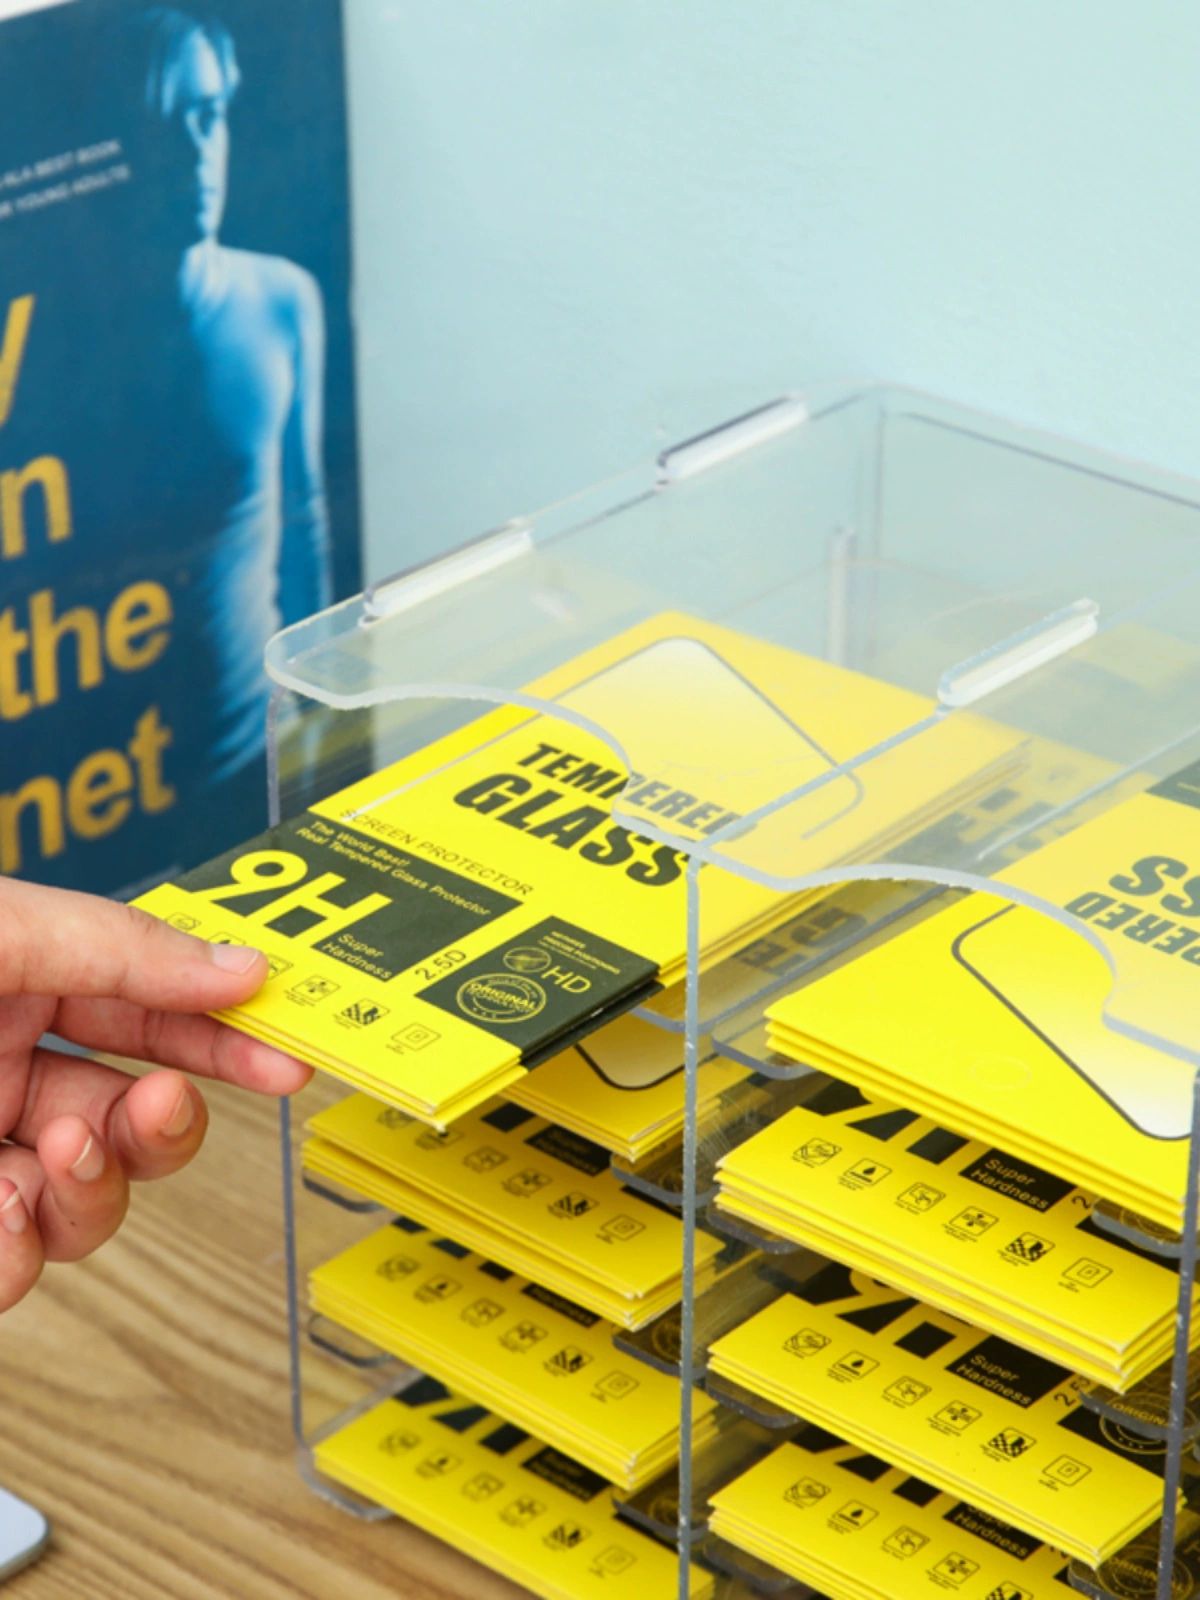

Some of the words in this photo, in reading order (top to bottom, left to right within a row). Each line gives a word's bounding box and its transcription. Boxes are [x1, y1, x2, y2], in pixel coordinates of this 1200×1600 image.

[0, 581, 172, 720] the
[311, 820, 335, 836] The
[453, 773, 702, 886] GLASS
[340, 810, 420, 845] SCREEN
[416, 839, 534, 897] PROTECTOR
[188, 850, 393, 946] 9H
[329, 839, 392, 873] Tempered
[391, 868, 428, 889] Glass
[428, 884, 492, 916] Protector
[321, 941, 394, 980] Hardness
[337, 933, 385, 959] Super
[414, 949, 467, 981] 2.5D
[541, 965, 592, 993] HD
[970, 1169, 1049, 1210] Hardness
[984, 1158, 1036, 1186] Super
[956, 1364, 1033, 1405] Hardness
[970, 1353, 1021, 1382] Super
[952, 1512, 1029, 1557] Hardness
